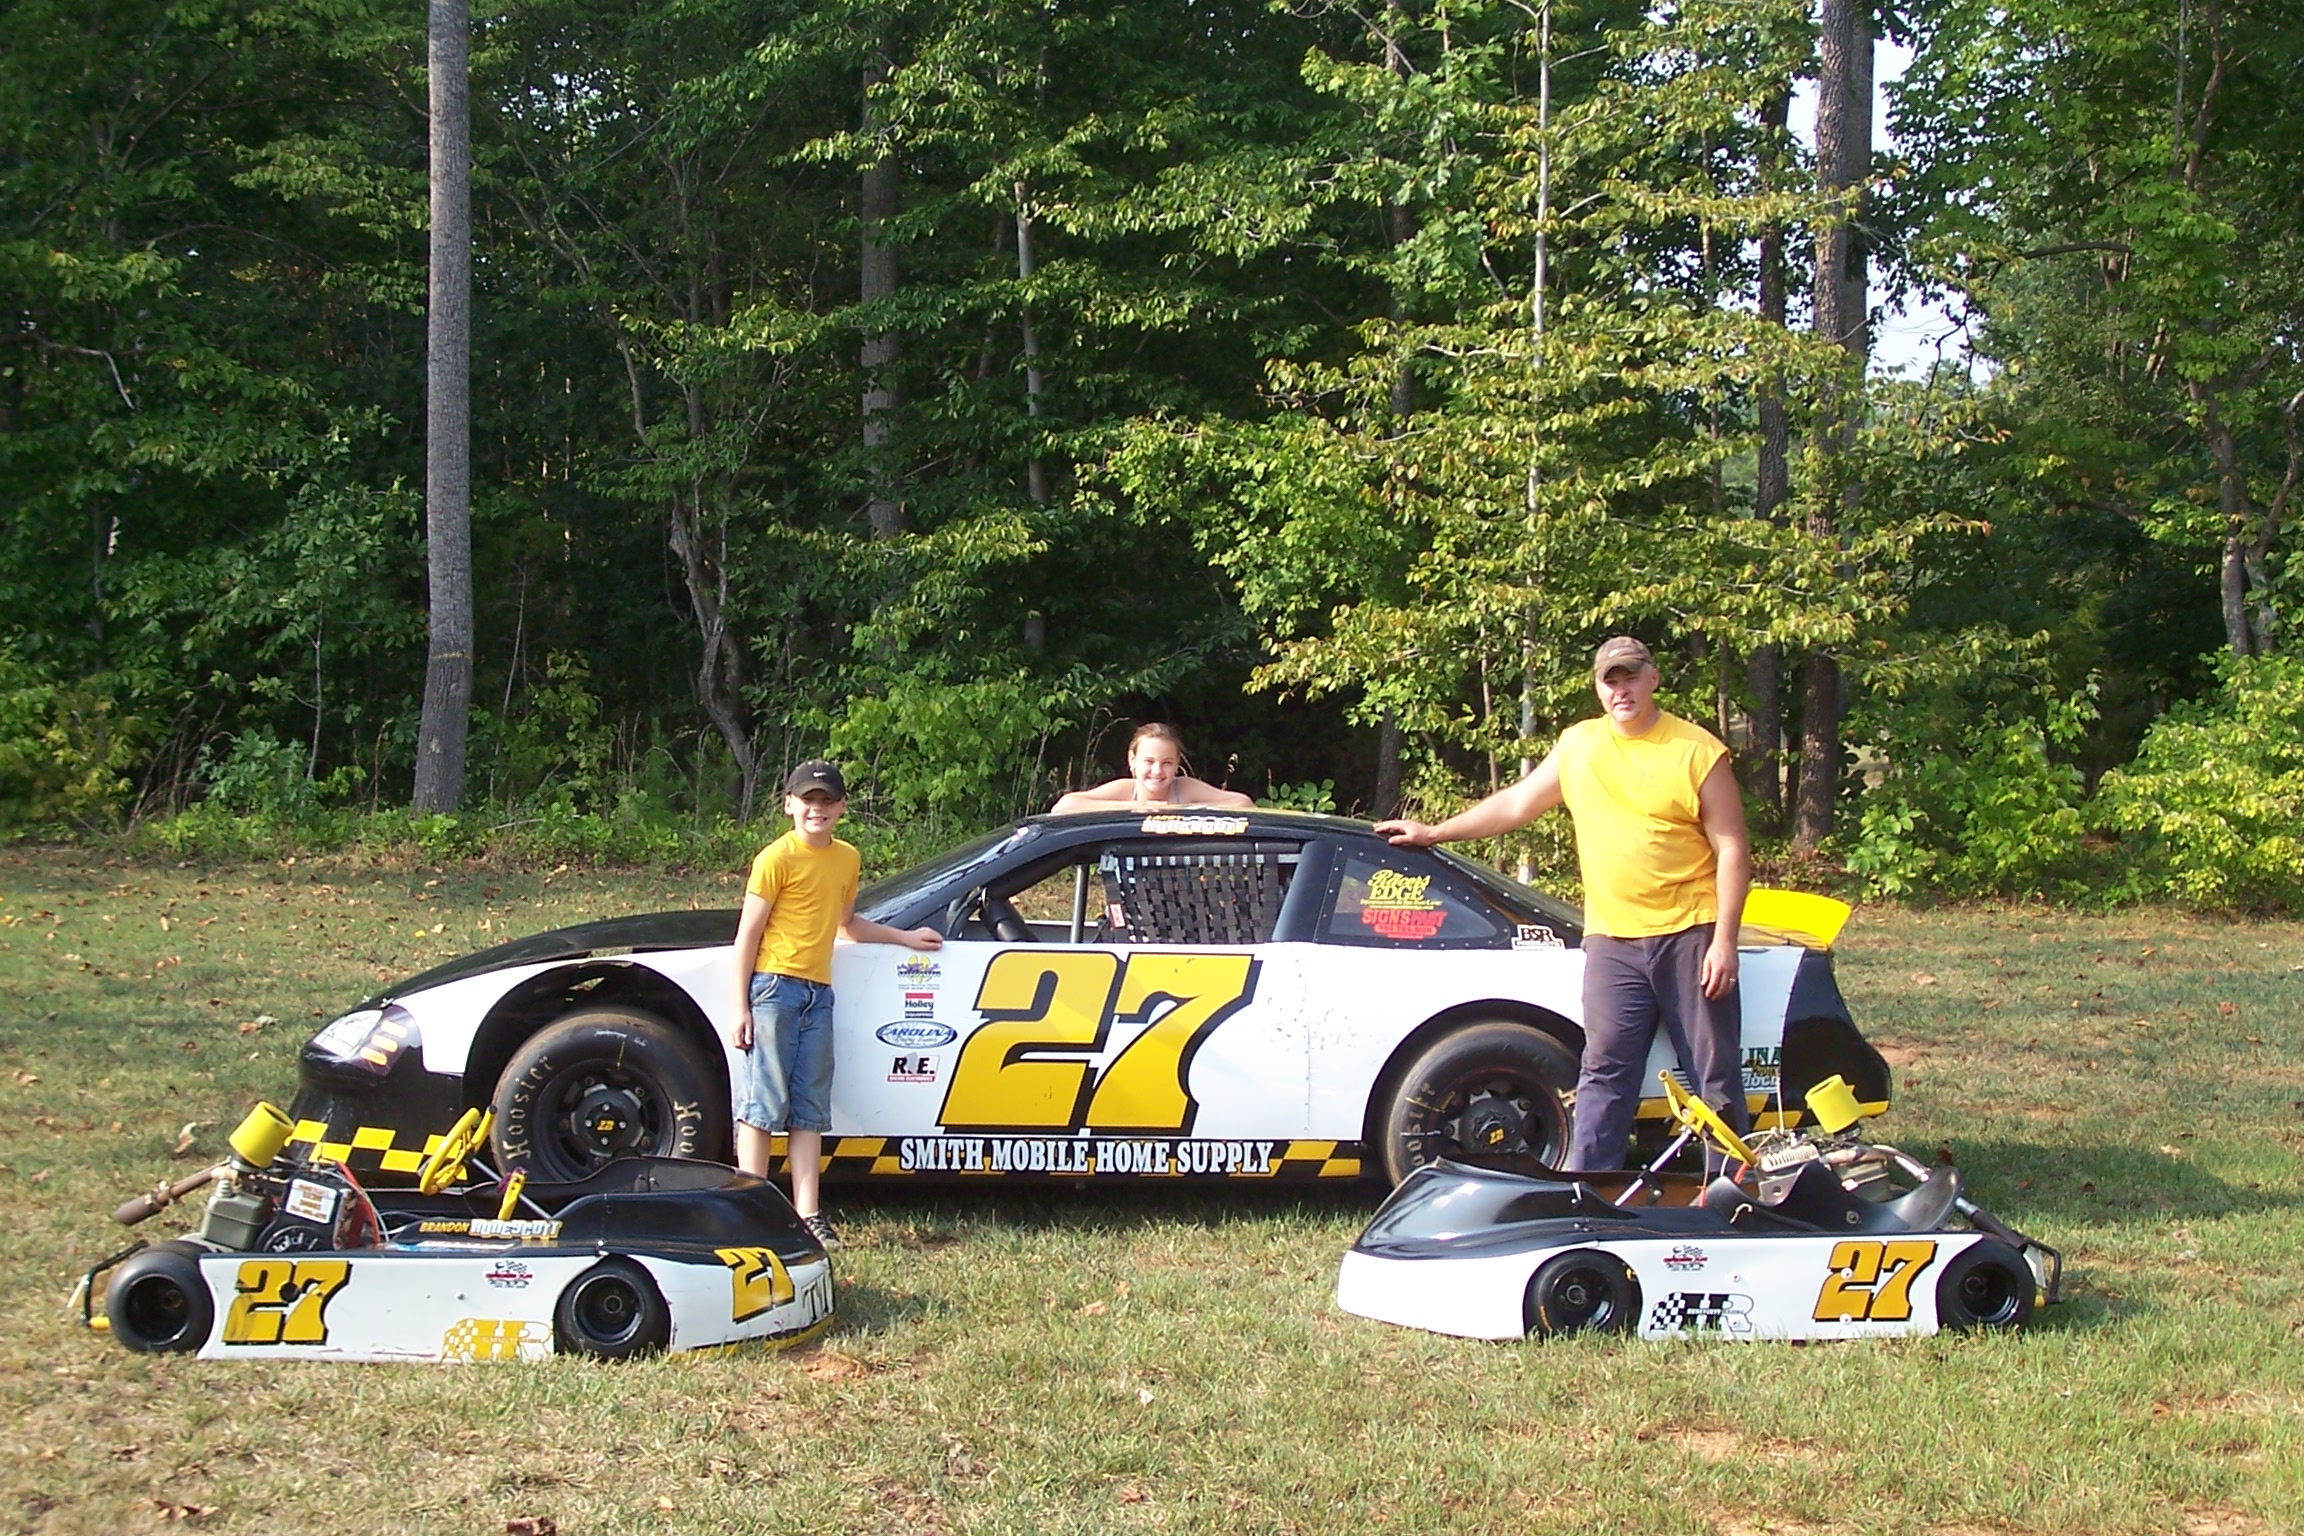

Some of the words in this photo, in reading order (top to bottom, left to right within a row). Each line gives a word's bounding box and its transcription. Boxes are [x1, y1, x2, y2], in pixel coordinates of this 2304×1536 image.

[1369, 886, 1425, 901] EDGE
[1521, 928, 1553, 941] BSR
[905, 1000, 934, 1011] Holley
[879, 1026, 954, 1037] CAROLINA
[936, 949, 1263, 1135] 27
[900, 1138, 985, 1171] SMITH
[991, 1140, 1089, 1172] MOBILE
[1096, 1142, 1170, 1173] HOME
[1177, 1142, 1274, 1174] SUPPLY
[419, 1221, 470, 1233] BRANDON
[714, 1246, 795, 1324] 27
[1812, 1240, 1939, 1322] 27
[222, 1260, 353, 1345] 27
